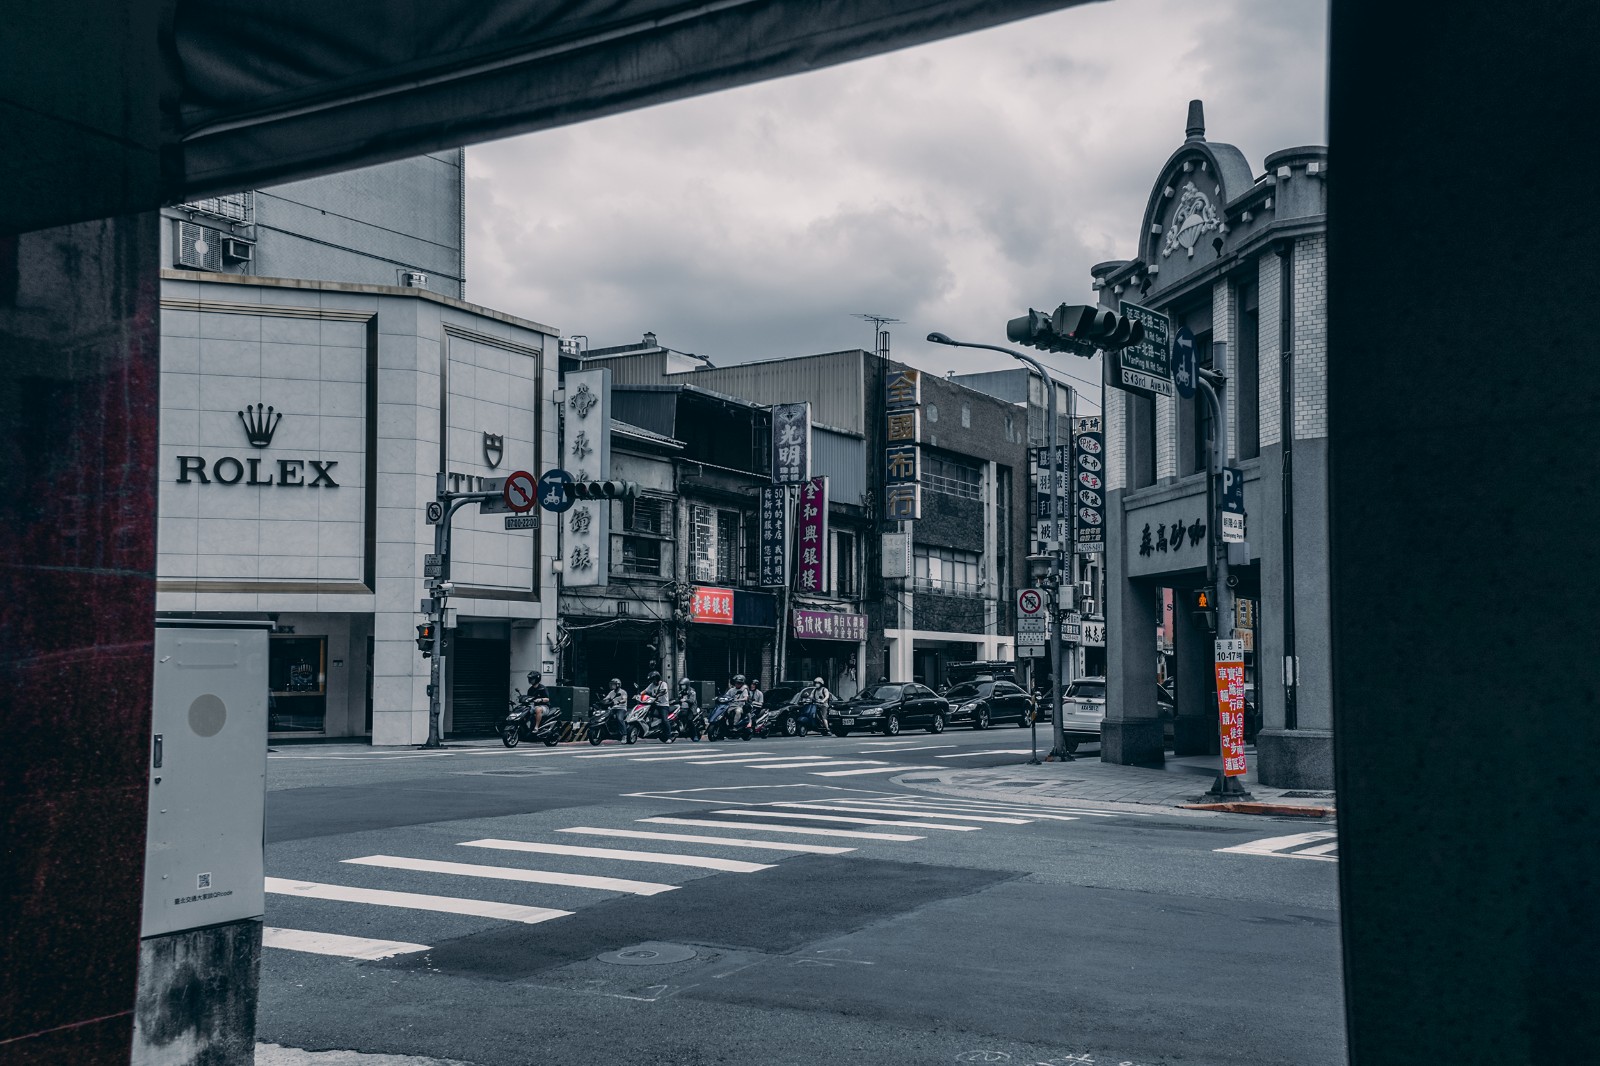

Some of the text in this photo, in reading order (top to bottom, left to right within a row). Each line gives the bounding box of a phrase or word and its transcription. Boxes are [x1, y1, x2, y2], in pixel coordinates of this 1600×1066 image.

[1124, 371, 1171, 394] S 3rd Ave. N
[779, 424, 802, 466] 光明
[887, 375, 916, 516] 全國布行
[176, 456, 340, 488] ROLEX
[1223, 469, 1233, 495] P
[802, 481, 820, 589] 金和興銀樓
[796, 615, 833, 635] 高價收購
[1218, 667, 1233, 770] 車輛請改道
[1227, 667, 1240, 770] 實施行人徒步區
